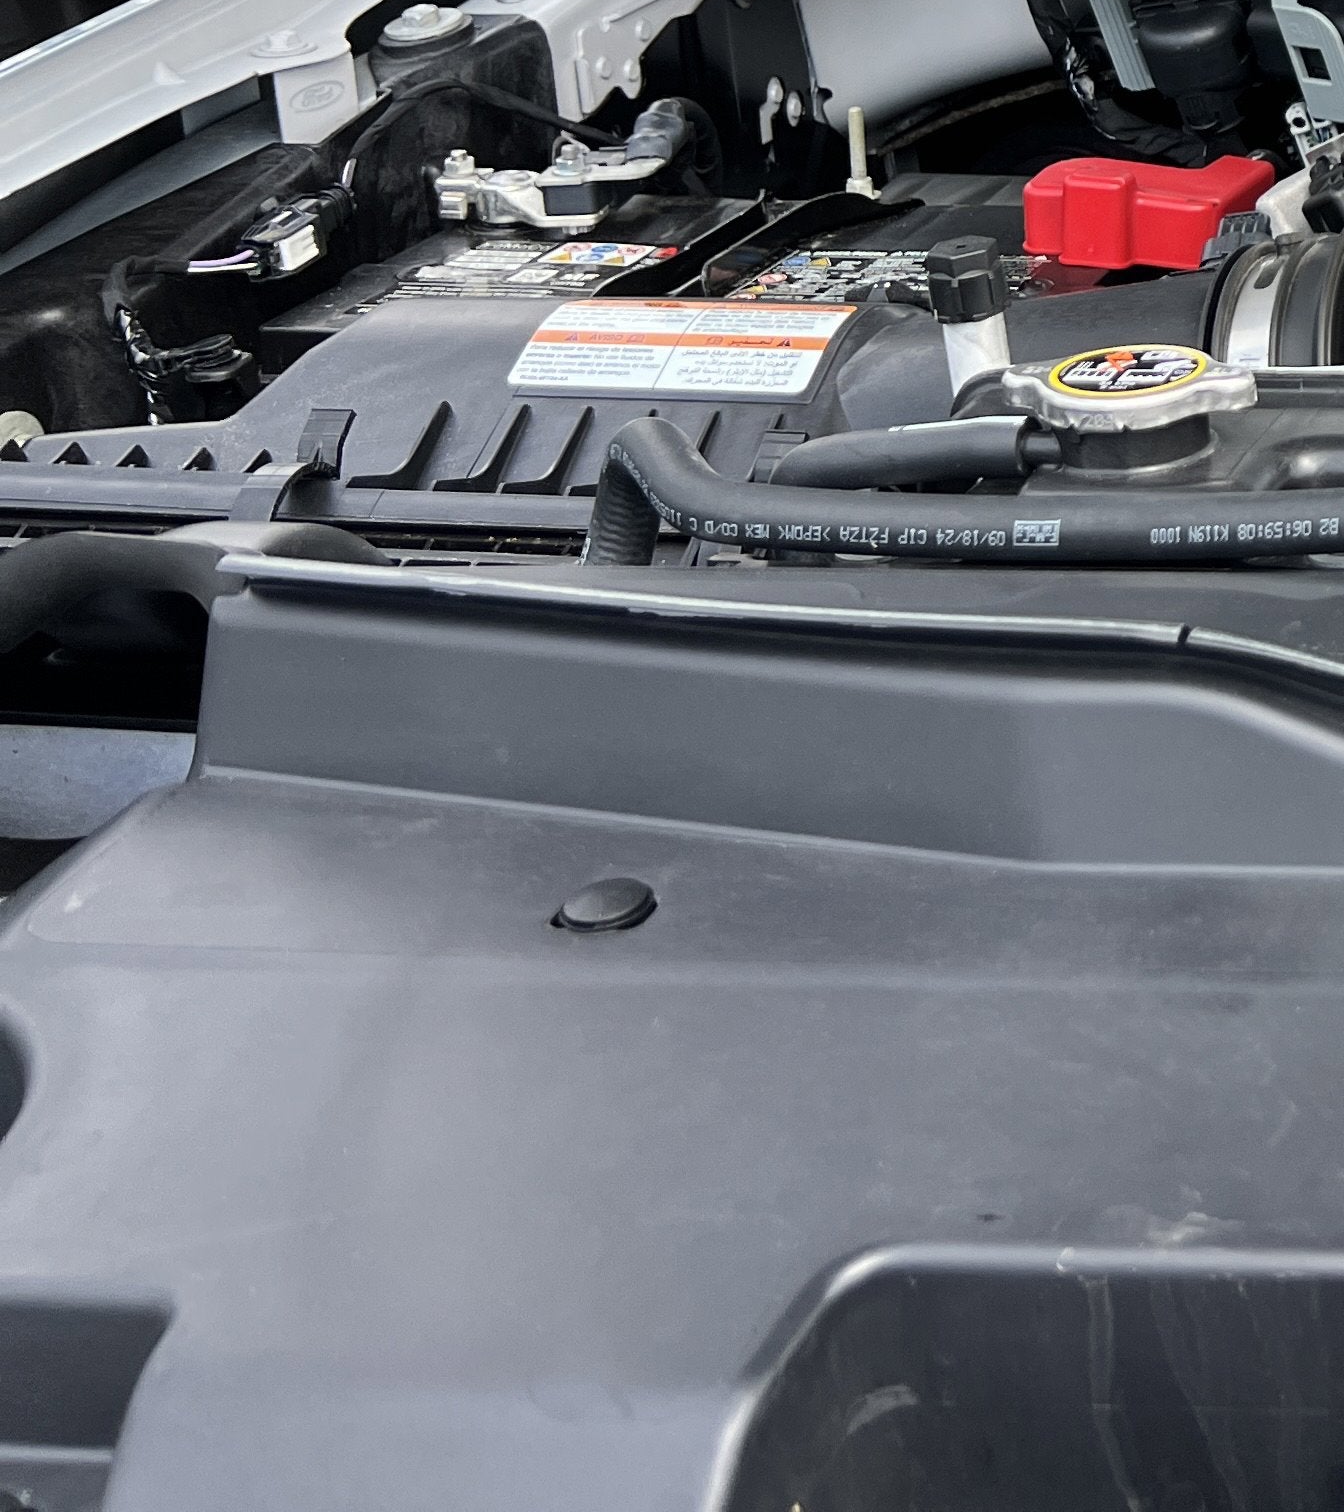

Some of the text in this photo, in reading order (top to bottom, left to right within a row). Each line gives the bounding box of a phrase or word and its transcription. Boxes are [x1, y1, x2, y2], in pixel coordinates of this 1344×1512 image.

[689, 517, 698, 532] C
[704, 520, 739, 537] CO/D
[744, 522, 770, 540] MEX
[1188, 524, 1229, 543] K119N
[1238, 520, 1312, 540] 06:59:08
[1319, 517, 1339, 535] B2
[898, 527, 928, 545] CIP
[936, 529, 1006, 546] 09/18/24
[1149, 527, 1181, 544] 1000
